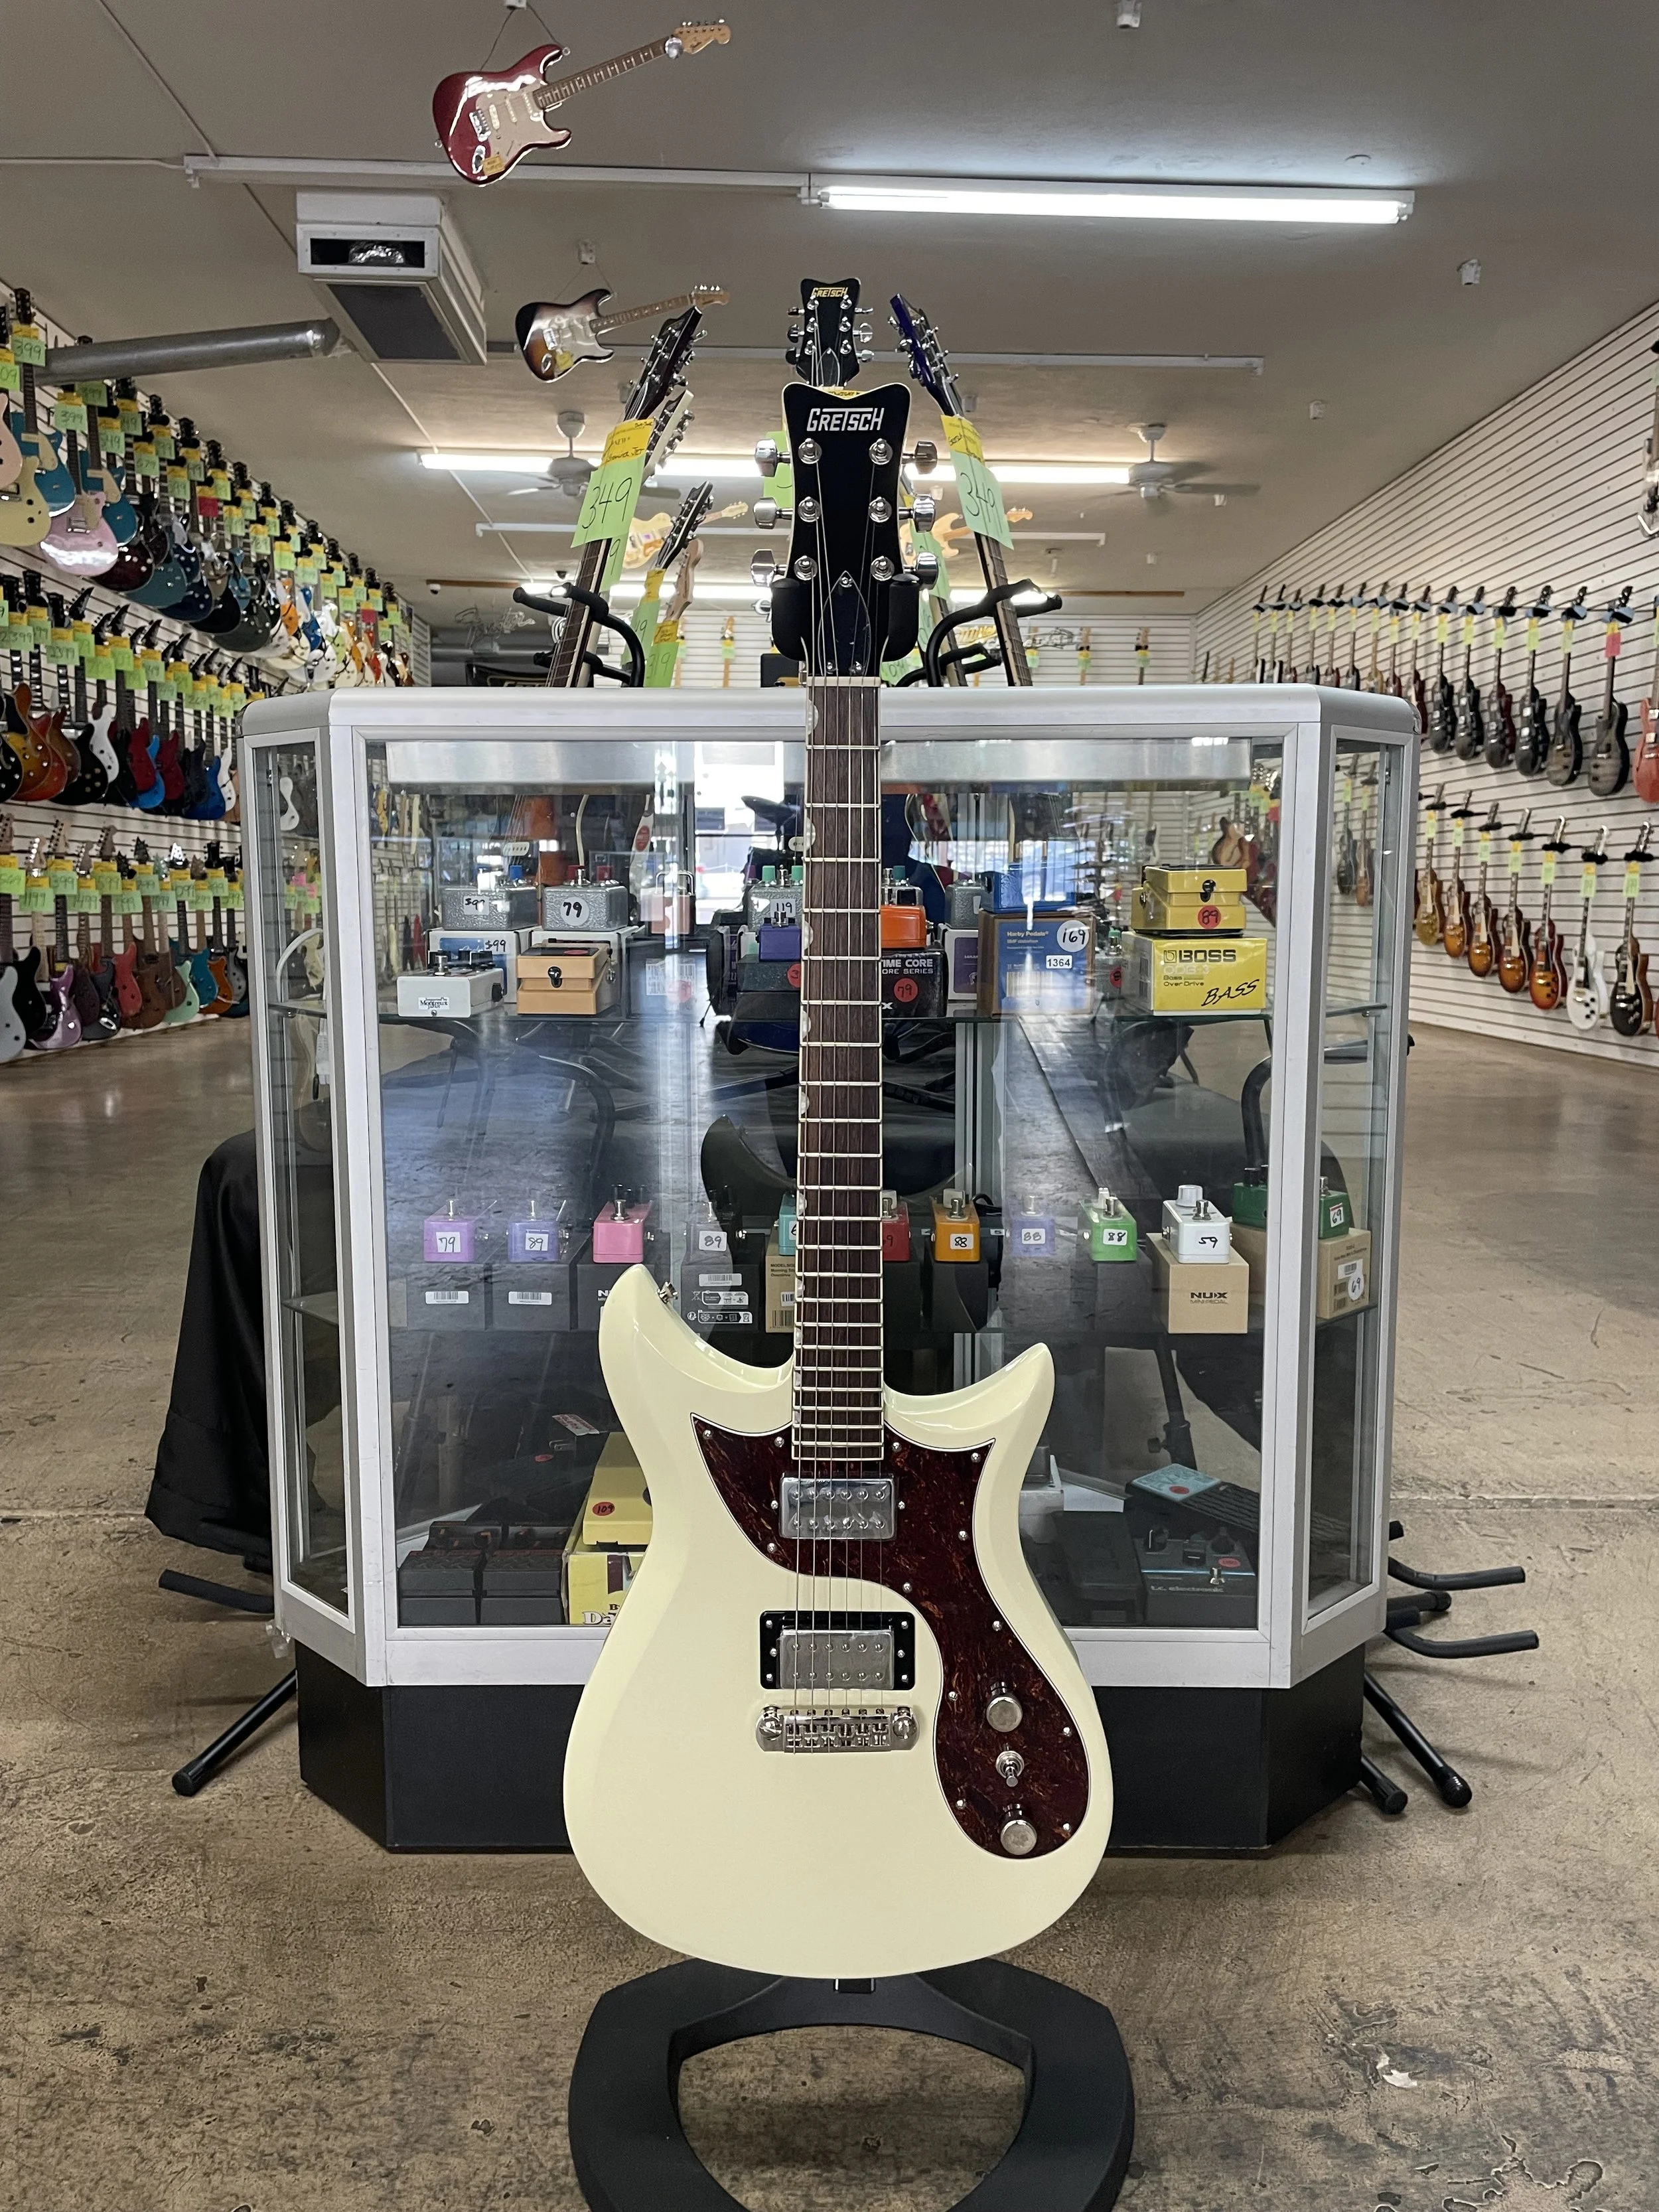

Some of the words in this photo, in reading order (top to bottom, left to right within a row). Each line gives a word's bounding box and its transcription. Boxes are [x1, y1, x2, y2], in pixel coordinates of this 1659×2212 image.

[812, 287, 849, 297] GRETSCH
[806, 407, 885, 431] GRETSCH
[582, 477, 632, 529] 349
[960, 472, 1003, 534] 349
[563, 901, 582, 918] 79
[776, 902, 792, 913] 119
[1202, 909, 1219, 924] 89
[1062, 928, 1086, 945] 169
[484, 939, 506, 952] $99
[881, 958, 902, 968] IME
[905, 958, 934, 968] CORE
[1047, 958, 1070, 967] 1364
[1179, 949, 1236, 963] BOSS
[897, 984, 912, 998] 79
[1201, 979, 1260, 1007] BASS
[1332, 1209, 1342, 1224] 69
[704, 1235, 722, 1248] 89
[1023, 1232, 1042, 1241] 88
[1108, 1232, 1126, 1242] 88
[1198, 1236, 1218, 1248] 59
[439, 1236, 455, 1252] 79
[528, 1237, 543, 1251] 89
[1352, 1277, 1361, 1293] 69
[598, 1505, 614, 1514] 109
